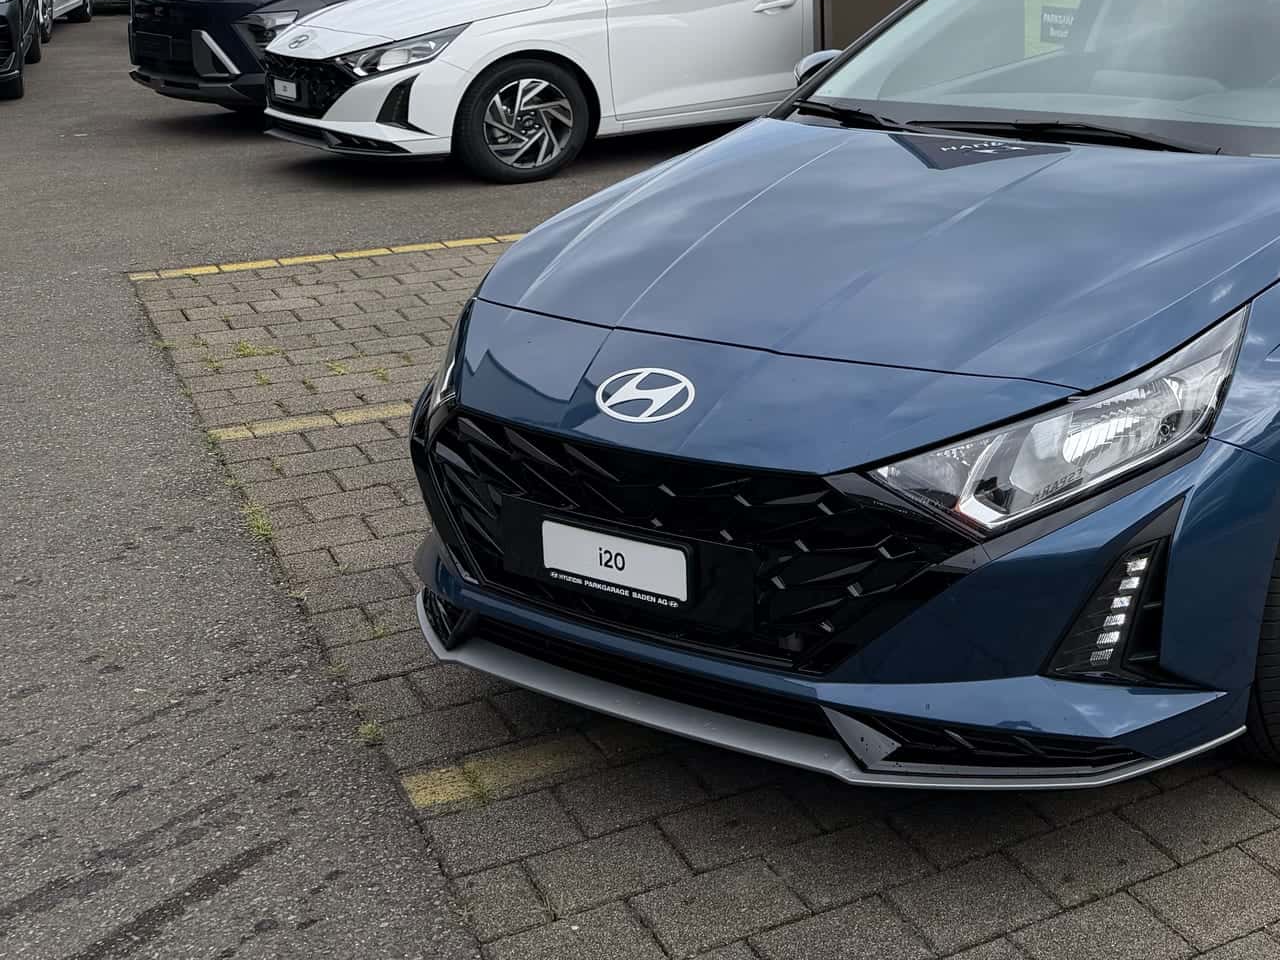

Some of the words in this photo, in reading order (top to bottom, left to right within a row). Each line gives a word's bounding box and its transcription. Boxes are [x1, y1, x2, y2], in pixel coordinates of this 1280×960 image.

[597, 547, 626, 572] i20
[584, 579, 630, 597] PARKGARAGE
[631, 591, 657, 604] BADEN
